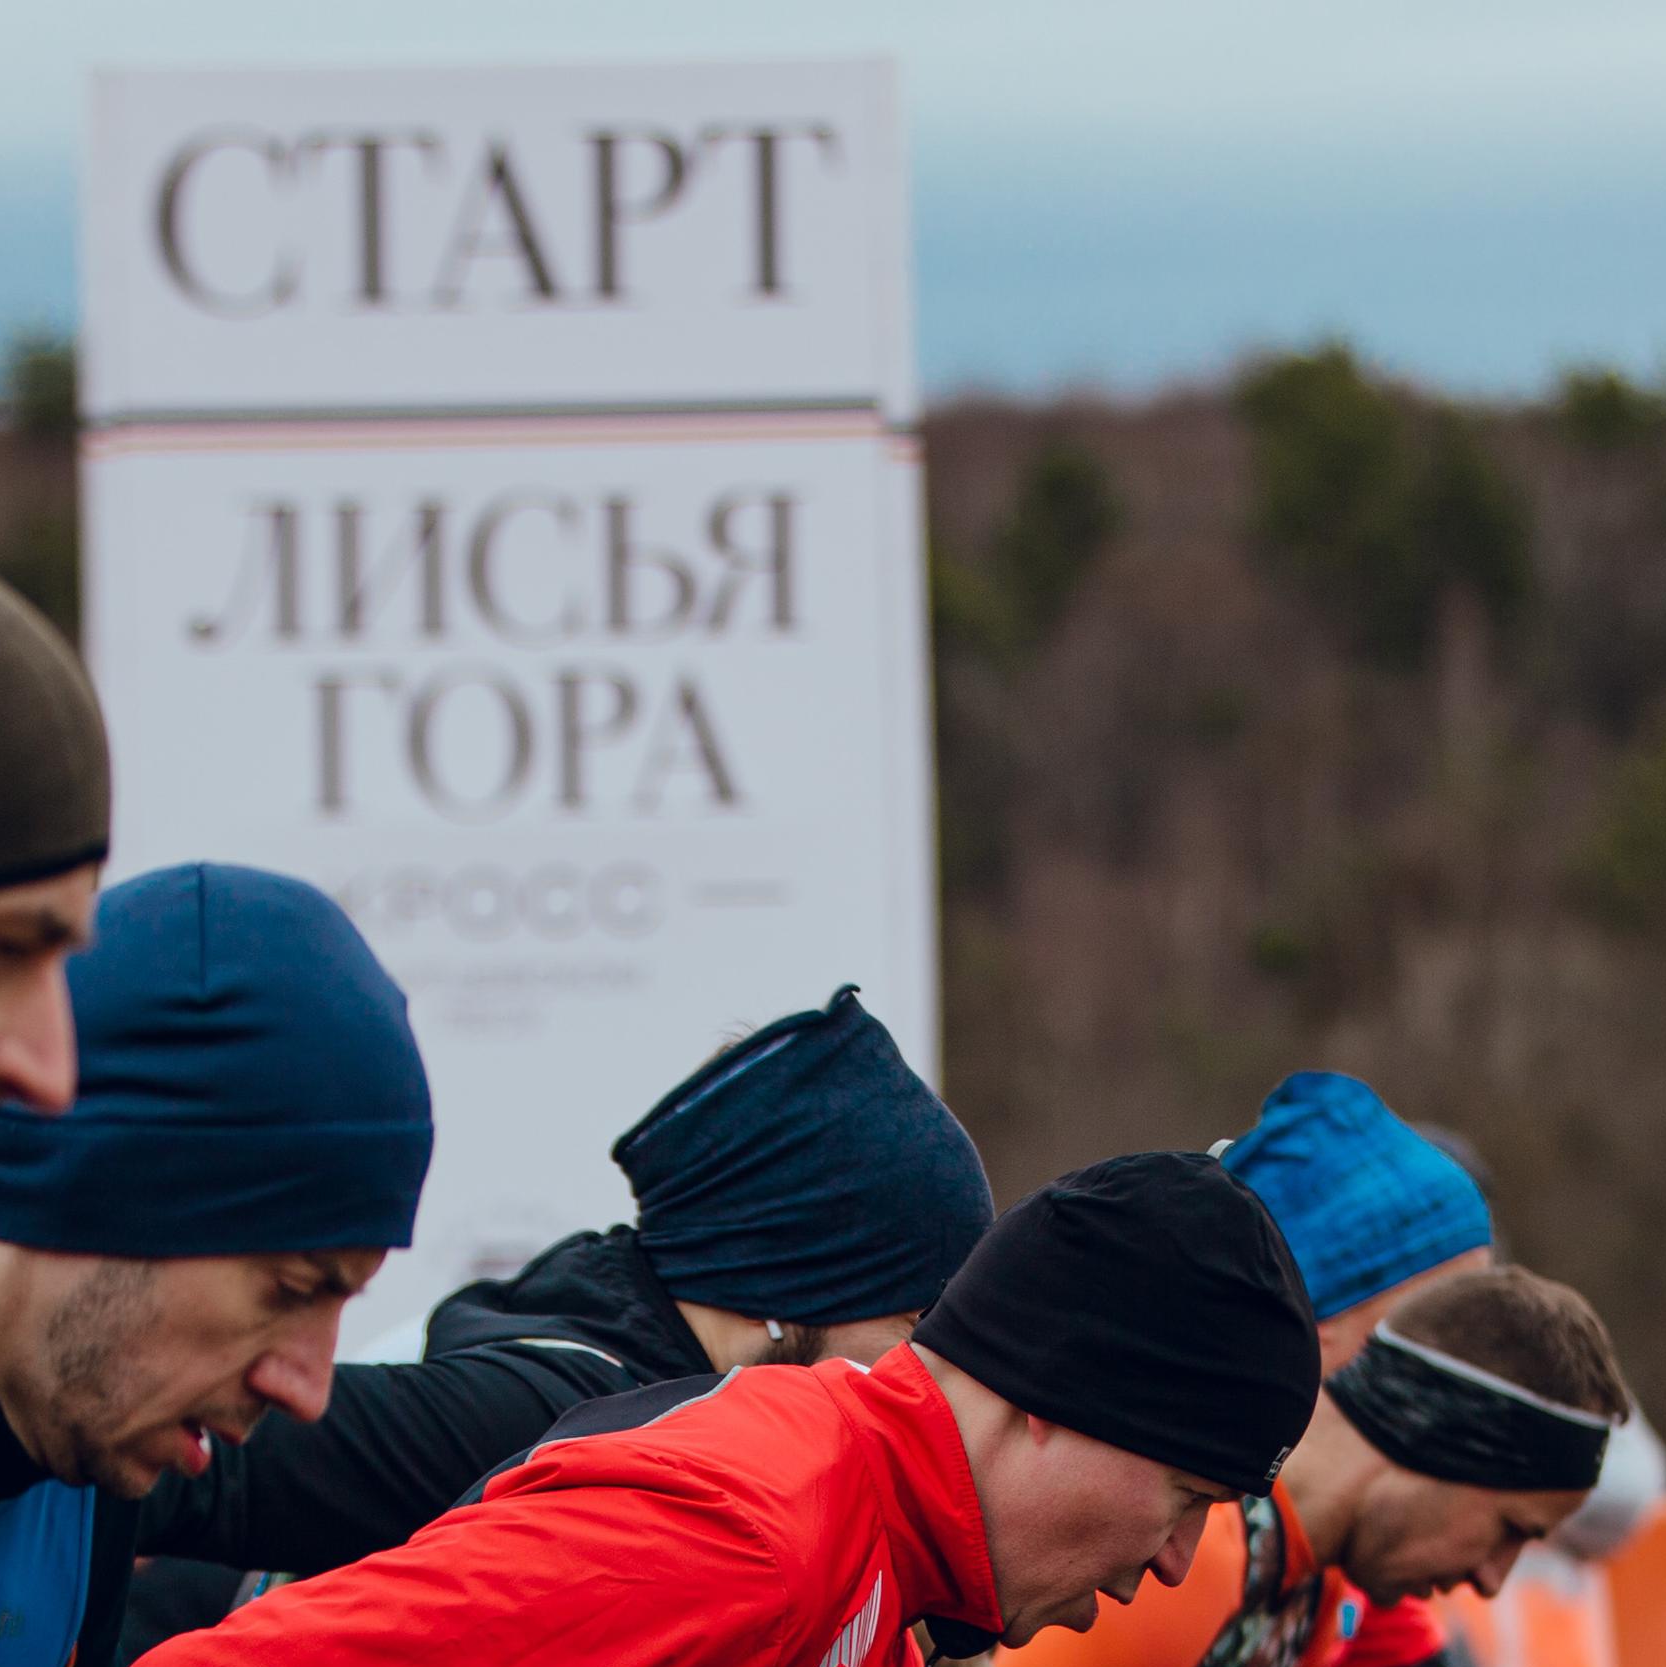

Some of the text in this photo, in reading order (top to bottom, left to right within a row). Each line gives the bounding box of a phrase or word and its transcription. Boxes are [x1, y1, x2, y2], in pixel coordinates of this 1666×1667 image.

[152, 124, 845, 322] СТАРТ
[185, 486, 801, 650] ЛИСЬЯ
[311, 660, 753, 826] ГОРА
